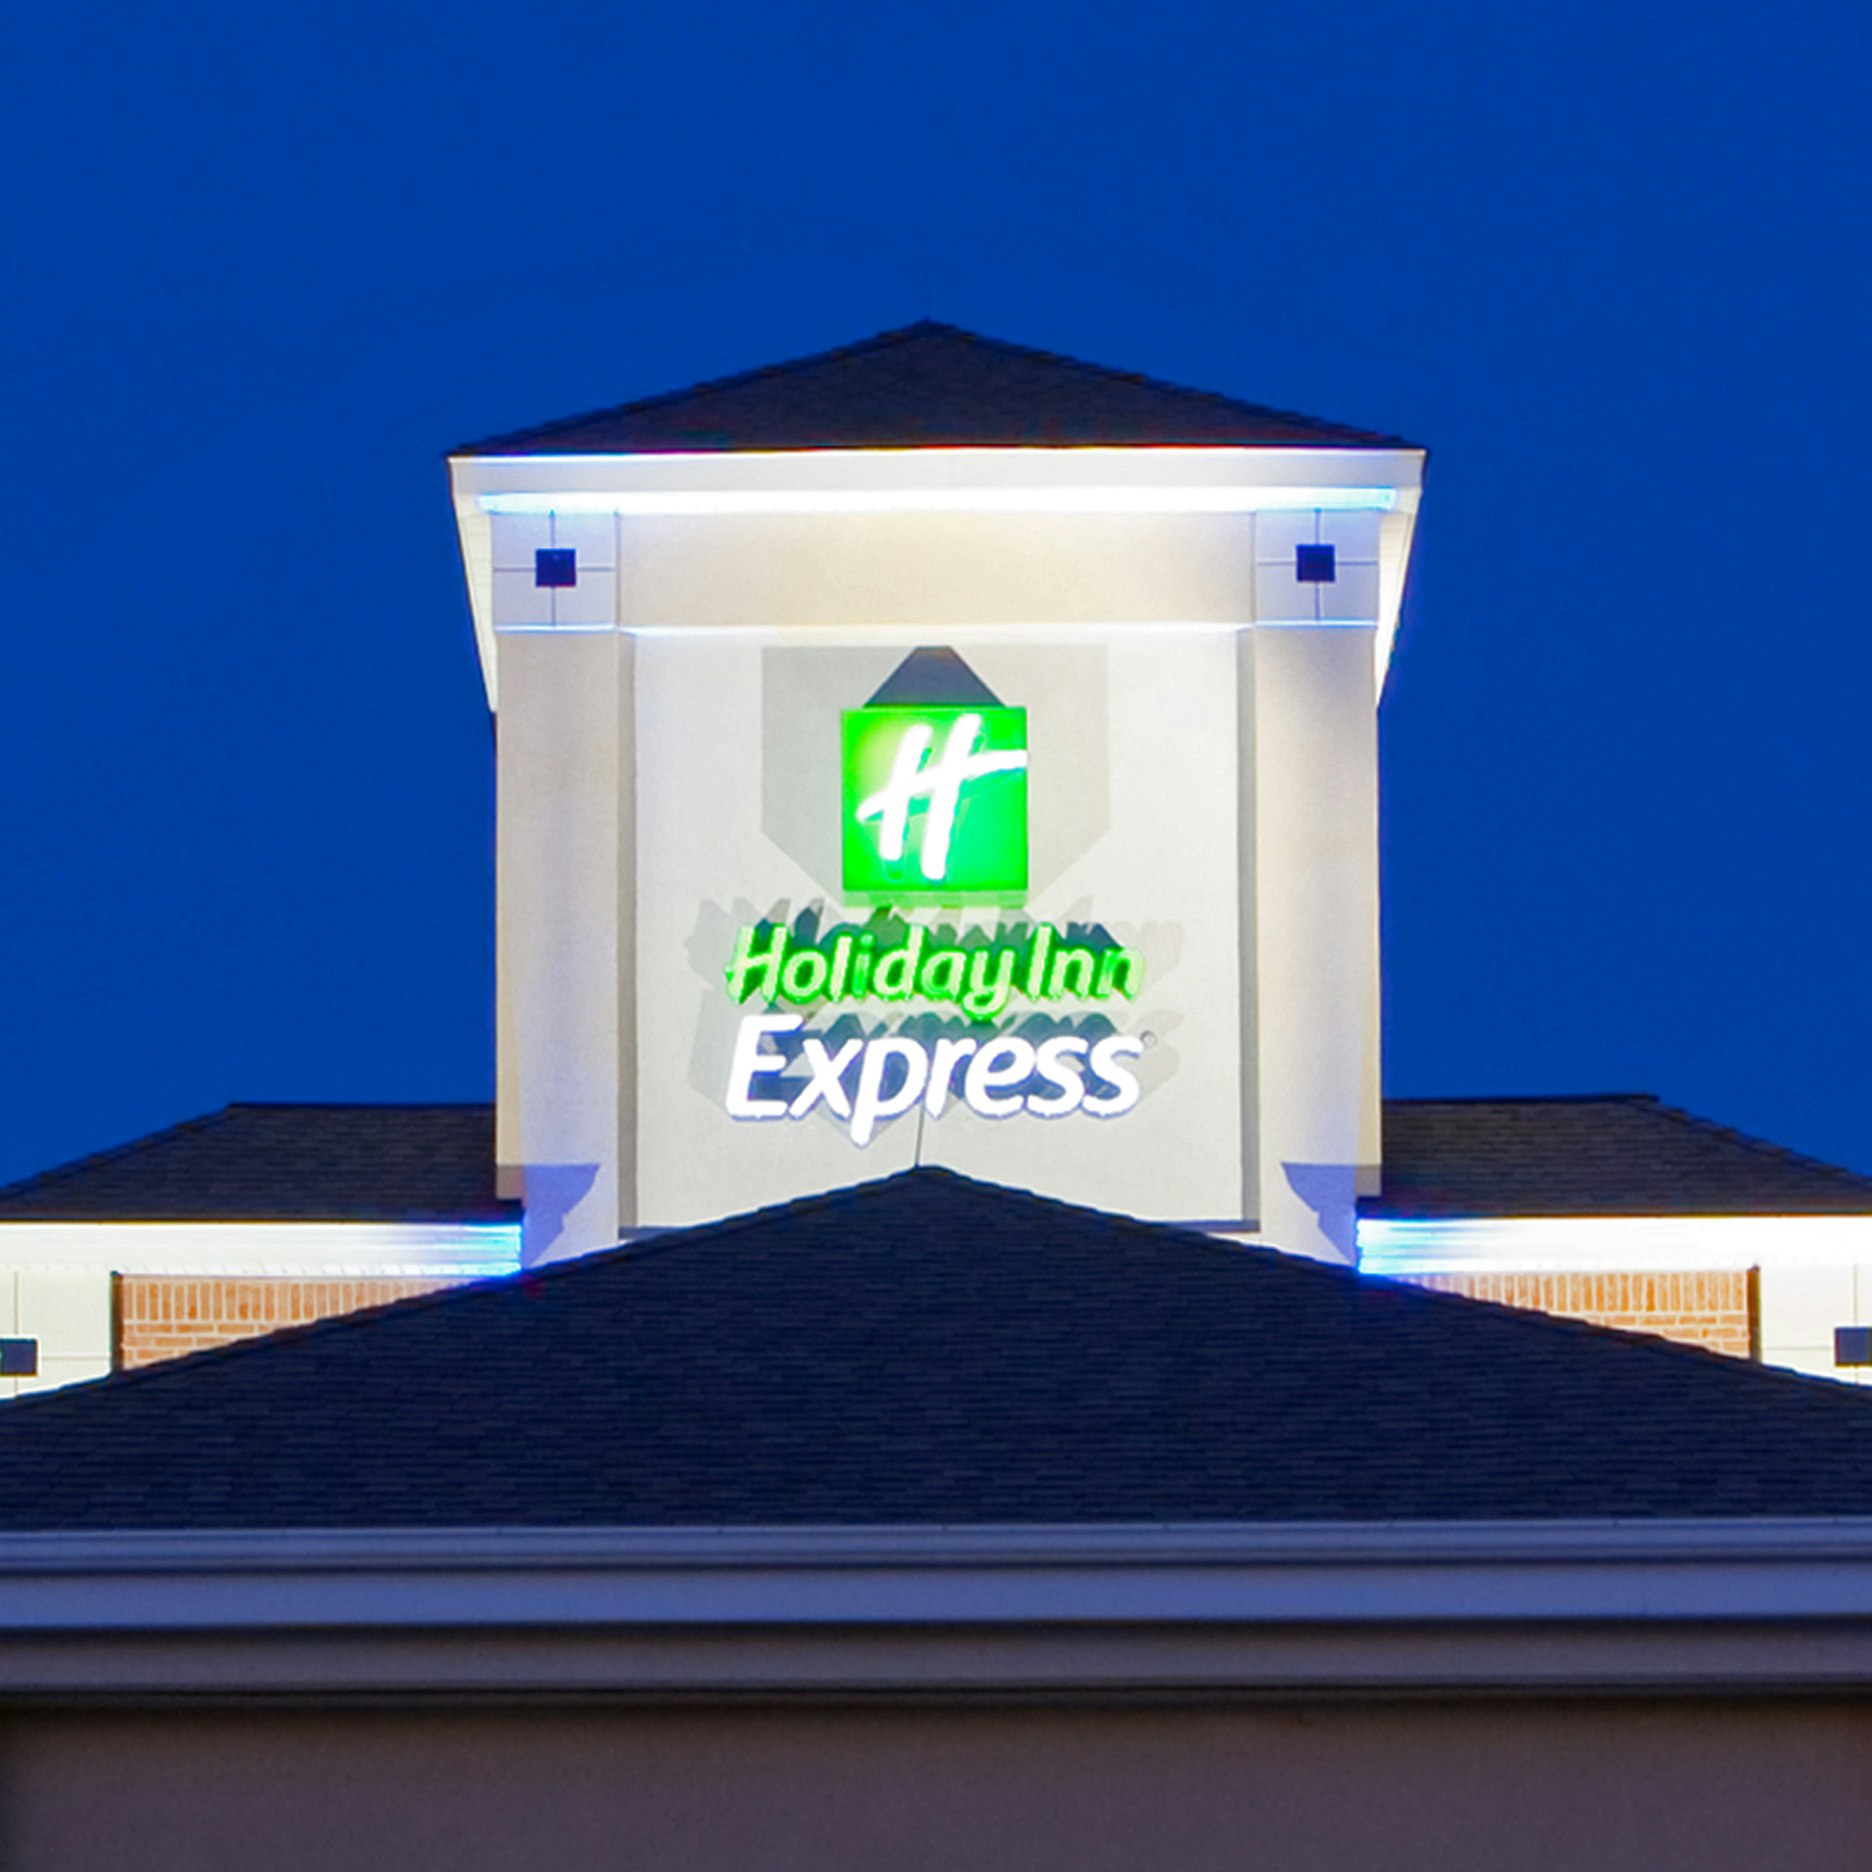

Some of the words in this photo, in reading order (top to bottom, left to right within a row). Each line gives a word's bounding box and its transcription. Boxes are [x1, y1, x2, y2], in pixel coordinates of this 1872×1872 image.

[855, 712, 1028, 880] H
[724, 922, 1014, 1022] Holiday
[1024, 922, 1146, 1002] Inn
[725, 1013, 1146, 1148] Express
